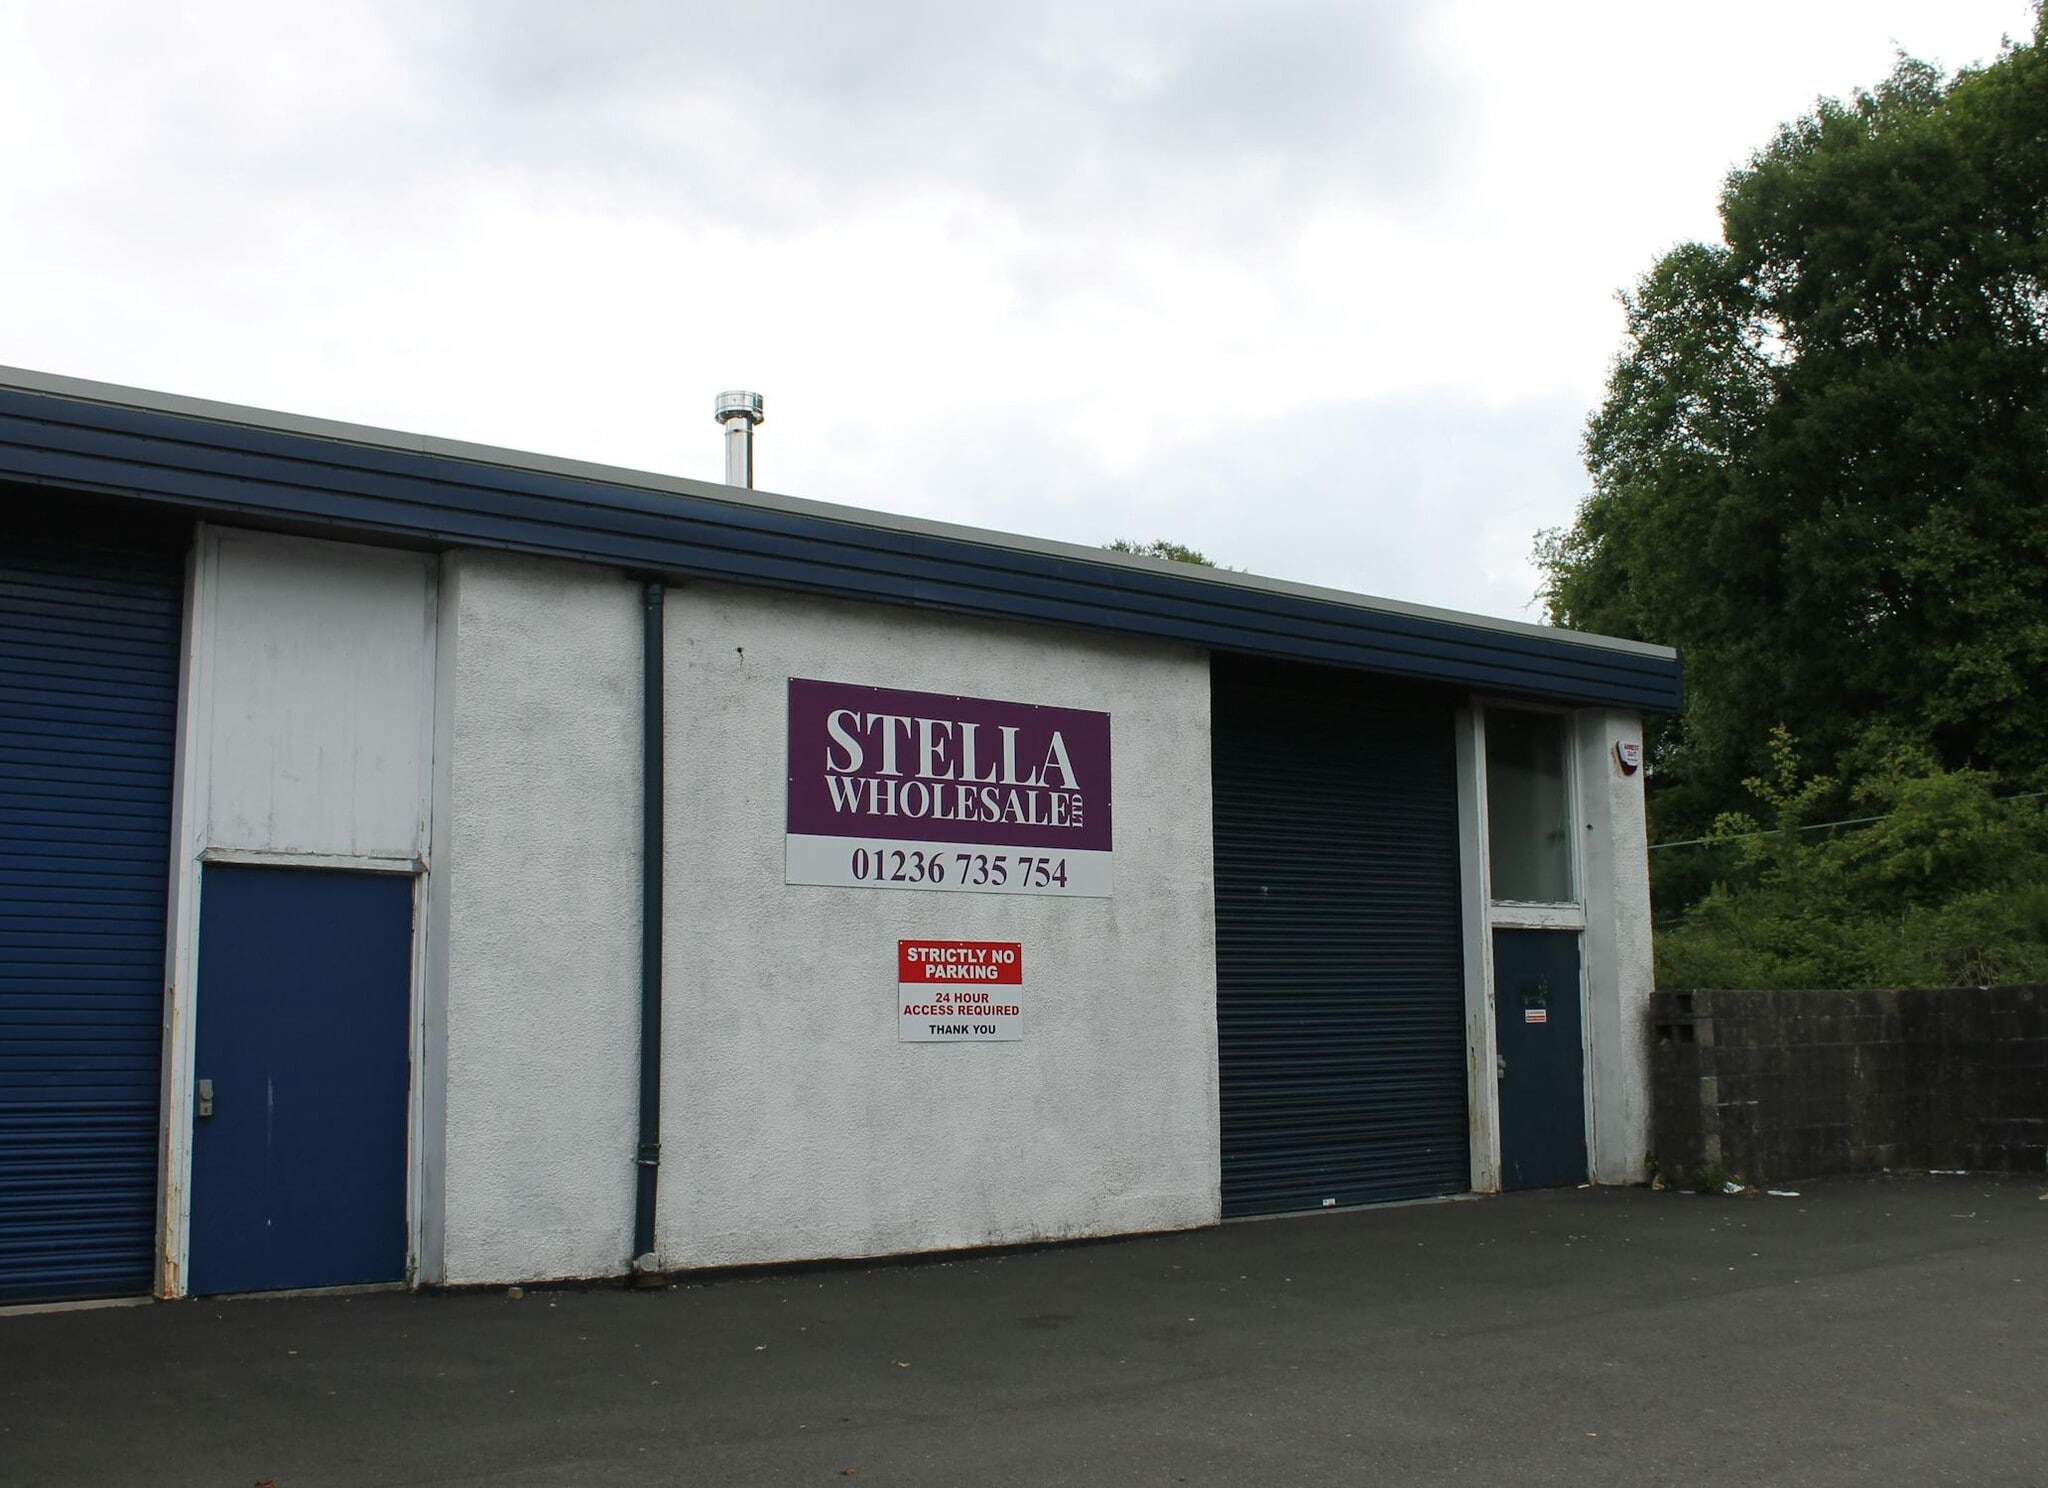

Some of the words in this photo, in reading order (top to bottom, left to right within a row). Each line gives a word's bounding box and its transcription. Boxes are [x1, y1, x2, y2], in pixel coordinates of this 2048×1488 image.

[826, 709, 1081, 790] STELLA
[824, 775, 1071, 828] WHOLESALE
[1071, 794, 1083, 828] LTD
[851, 848, 945, 884] 01236
[956, 854, 1008, 886] 735
[1018, 857, 1067, 888] 754
[907, 947, 987, 963] STRICTLY
[992, 950, 1015, 964] NO
[925, 964, 999, 979] PARKING
[935, 992, 950, 1003] 24
[954, 993, 989, 1004] HOUR
[903, 1005, 954, 1016] ACCESS
[958, 1005, 1019, 1017] REQUIRED
[929, 1025, 969, 1035] THANK
[973, 1025, 996, 1035] YOU
